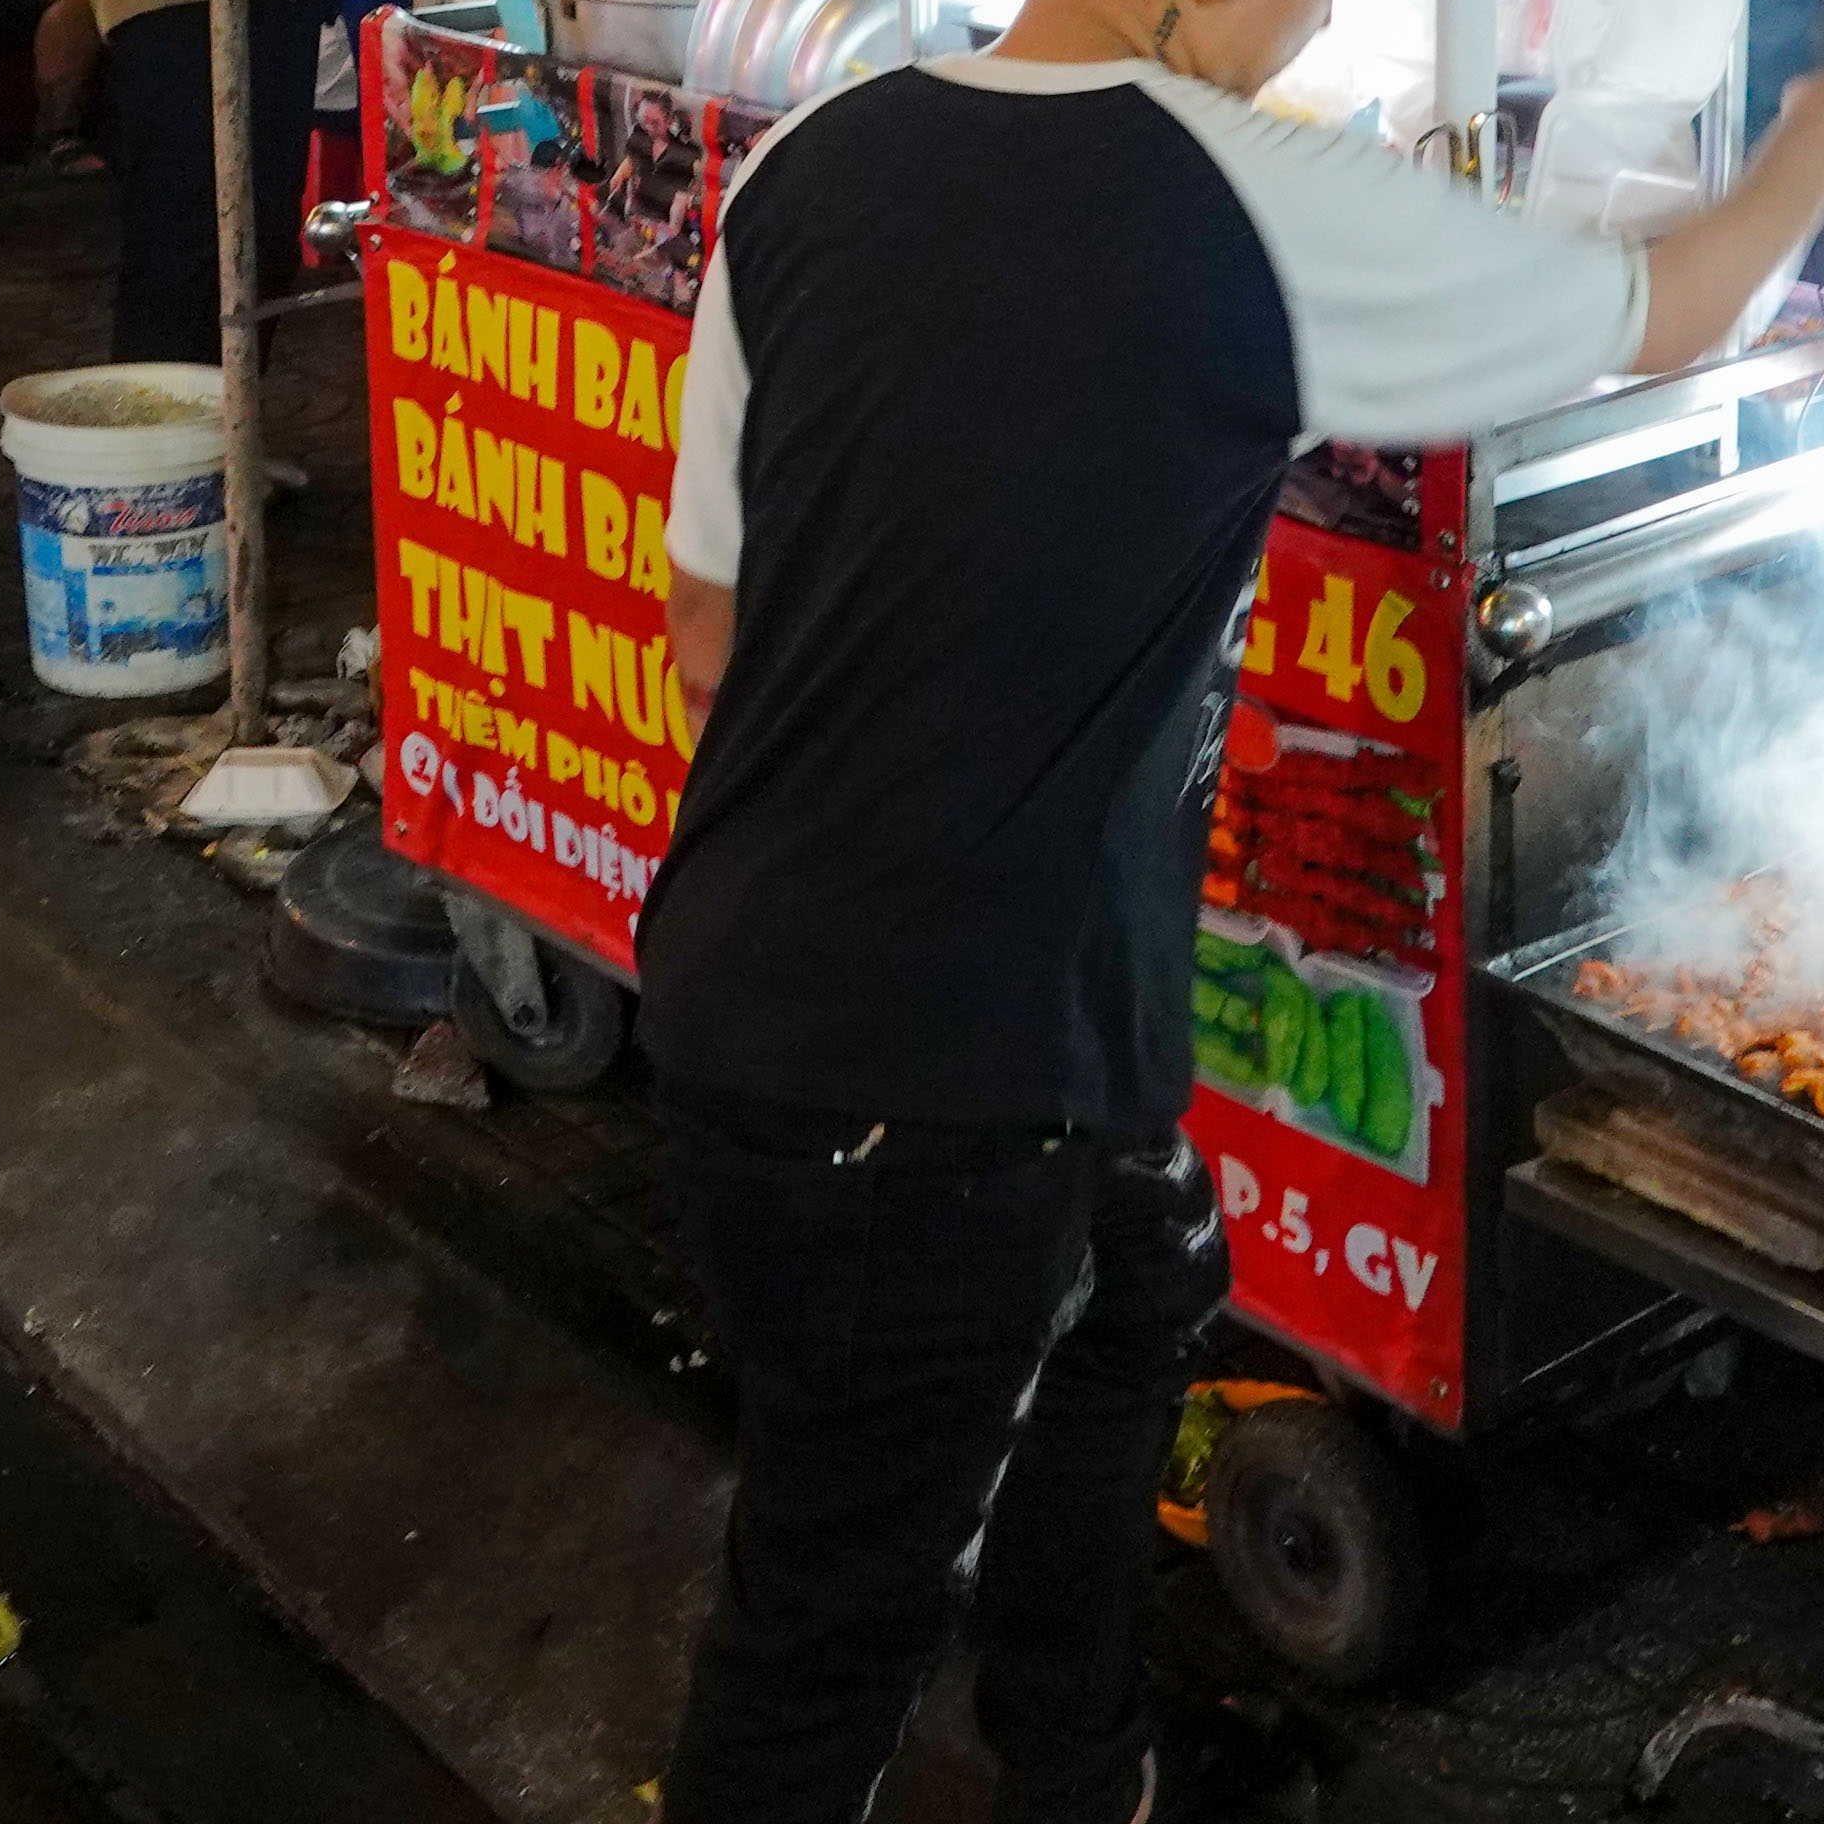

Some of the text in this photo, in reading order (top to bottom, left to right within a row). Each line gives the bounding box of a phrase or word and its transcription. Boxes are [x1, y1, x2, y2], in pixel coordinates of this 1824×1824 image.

[387, 248, 560, 411] BÁNH
[393, 390, 567, 559] BÁNH
[399, 538, 555, 698] THỊT
[1297, 575, 1426, 723] 46
[1344, 1223, 1439, 1313] GV
